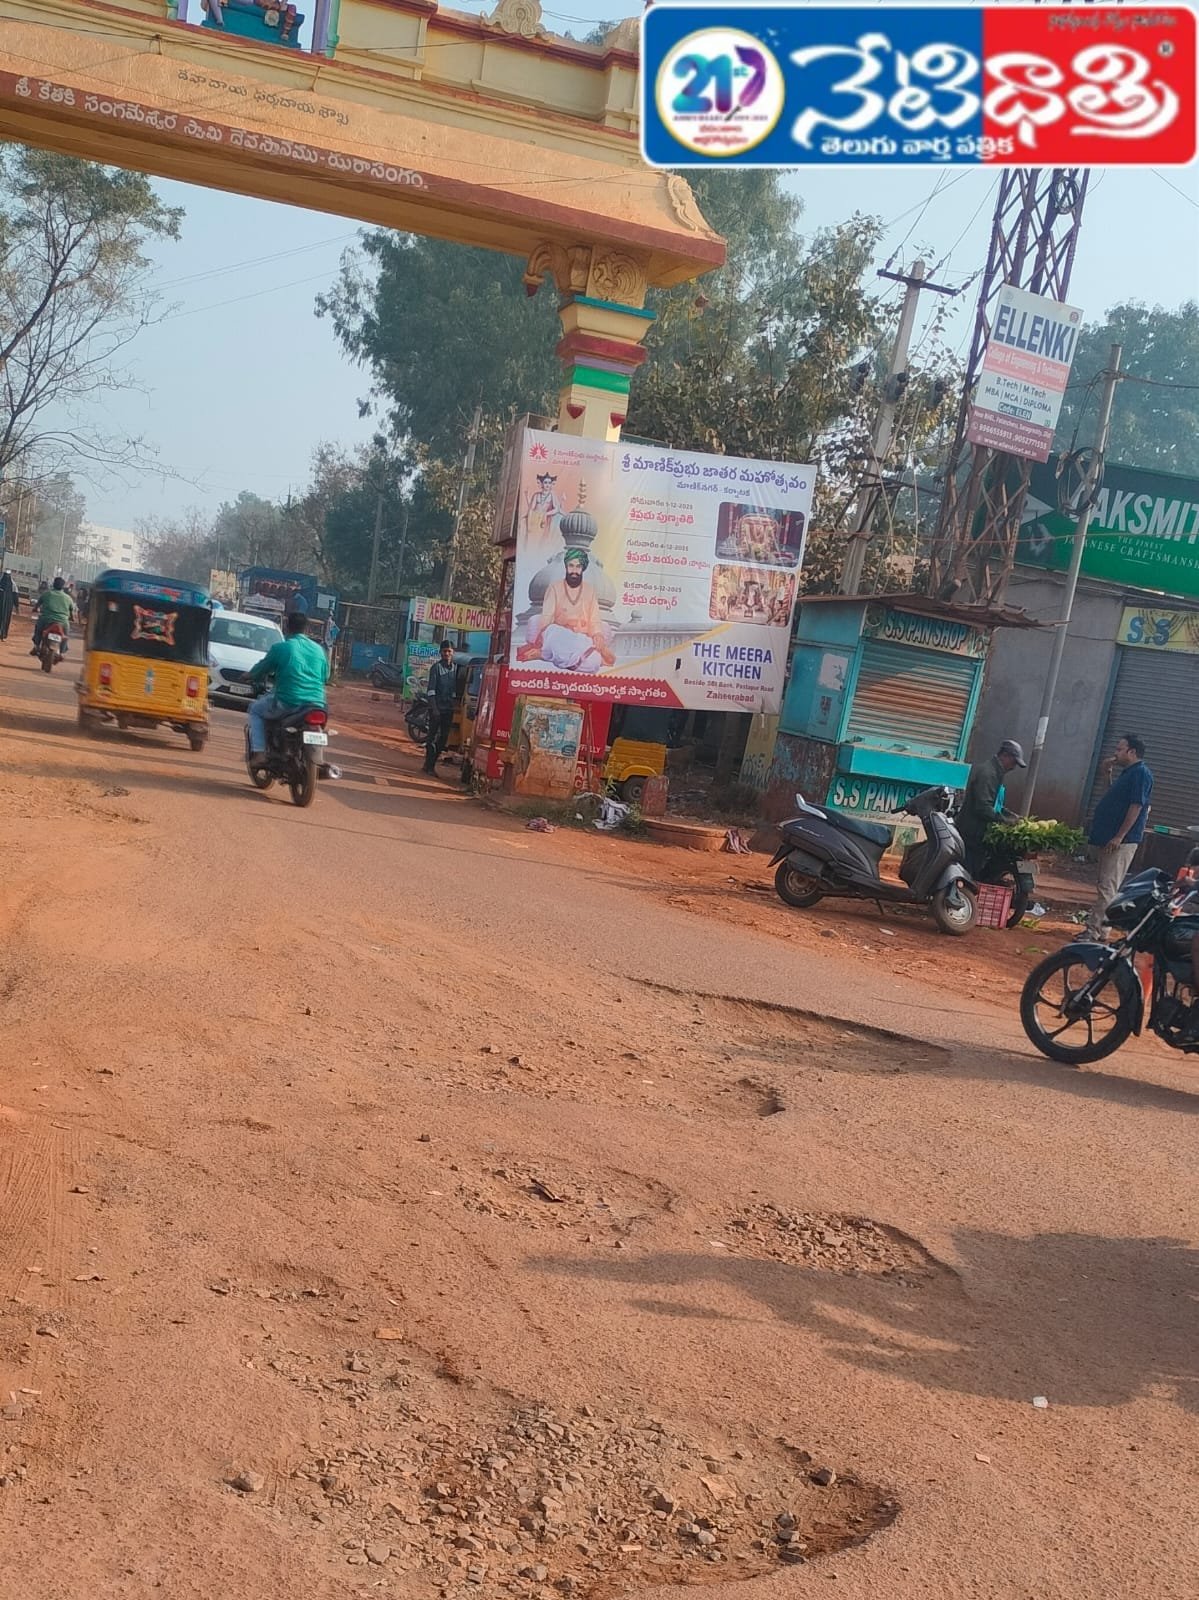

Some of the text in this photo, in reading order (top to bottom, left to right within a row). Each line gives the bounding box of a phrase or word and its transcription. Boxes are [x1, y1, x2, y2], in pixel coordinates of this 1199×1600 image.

[16, 76, 31, 97] శ్రీ
[993, 304, 1076, 363] ELLENKI
[996, 377, 1046, 398] B.Tech M.Tech
[985, 386, 1051, 413] MBA MCA DIPLOMA
[621, 453, 631, 472] శ్రీ
[703, 465, 738, 480] జాతర
[739, 470, 807, 494] మహోత్సవం
[1118, 536, 1164, 550] THE FINEST
[429, 602, 457, 623] XEROX
[457, 607, 463, 624] &
[906, 620, 930, 645] PAN
[932, 622, 967, 650] SHOP
[693, 642, 772, 664] THE MEERA
[703, 661, 762, 680] KITCHEN
[511, 677, 667, 700] అందరికీ హృదయపూర్వక స్వాగతం
[684, 678, 705, 687] Beside
[706, 690, 755, 702] Zaheerabad
[863, 782, 900, 813] PAN
